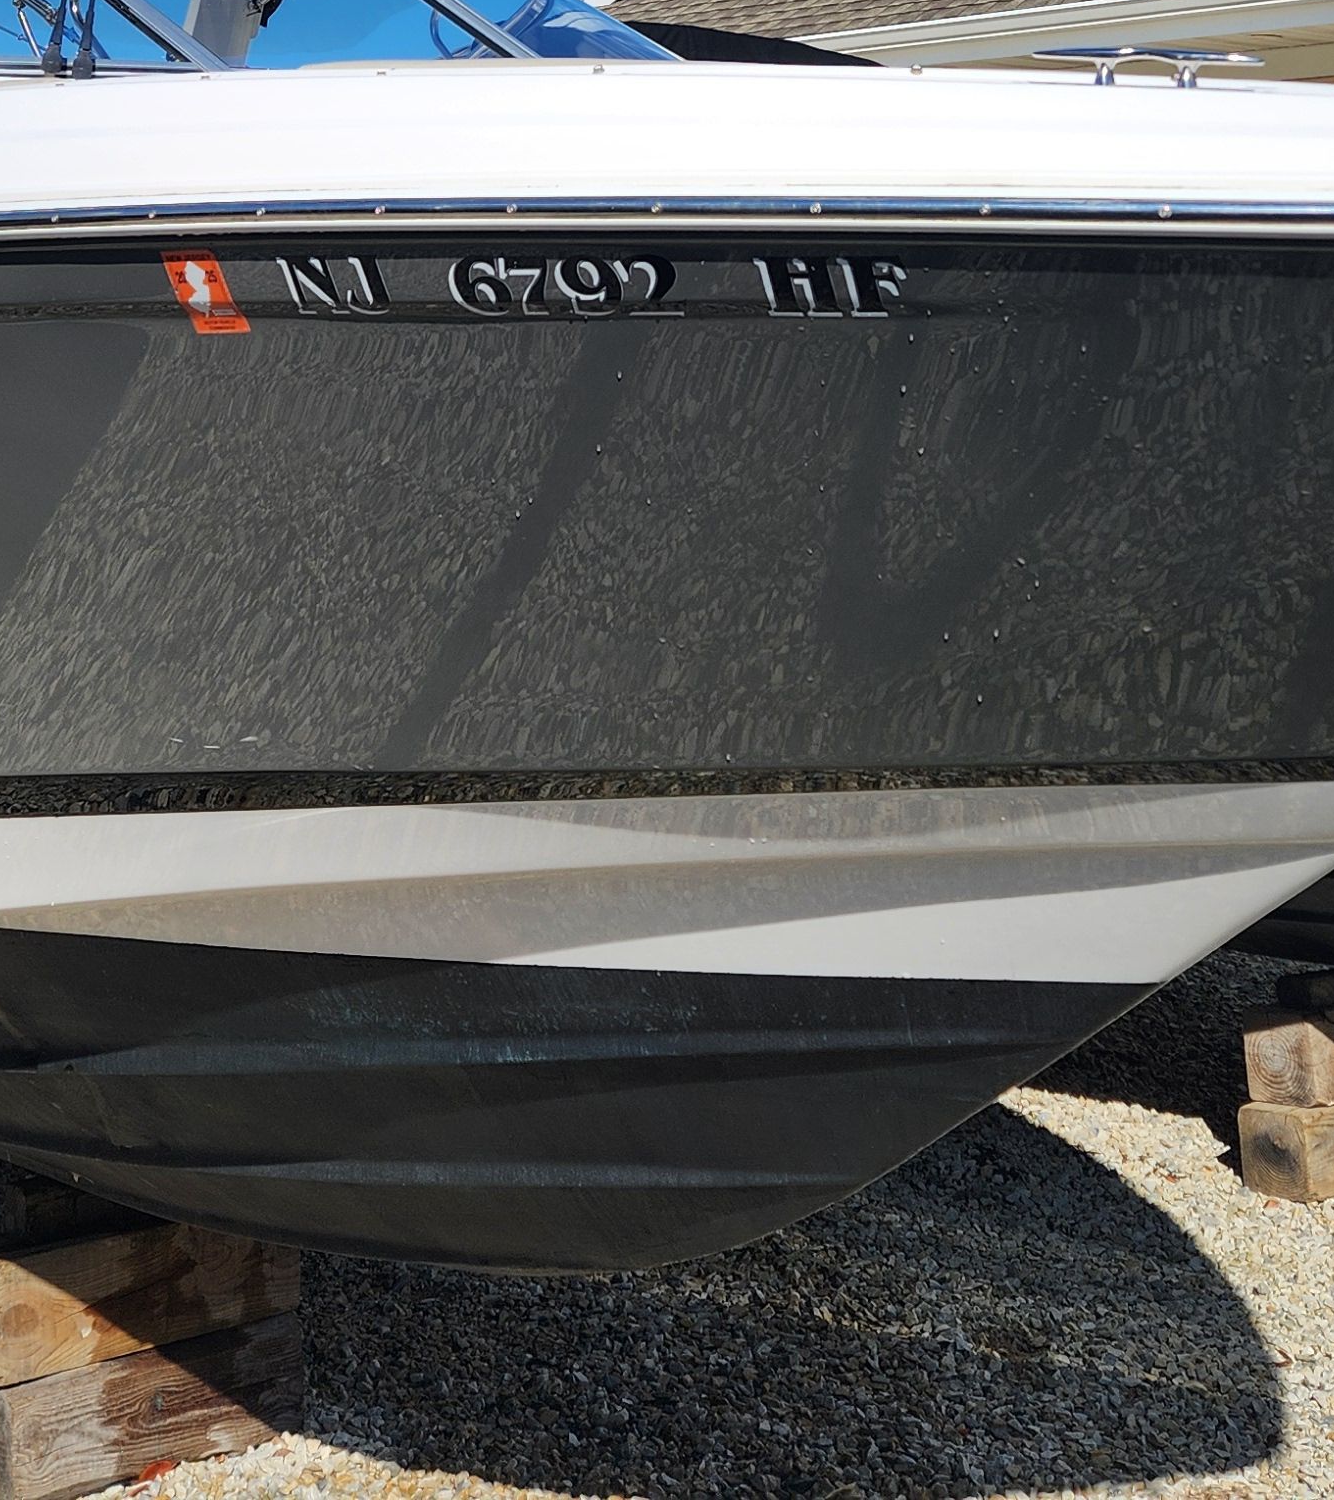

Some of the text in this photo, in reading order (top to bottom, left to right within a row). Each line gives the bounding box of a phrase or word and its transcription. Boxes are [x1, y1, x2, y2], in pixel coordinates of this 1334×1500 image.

[205, 269, 218, 282] 25
[275, 254, 907, 318] NJ 6792 HF
